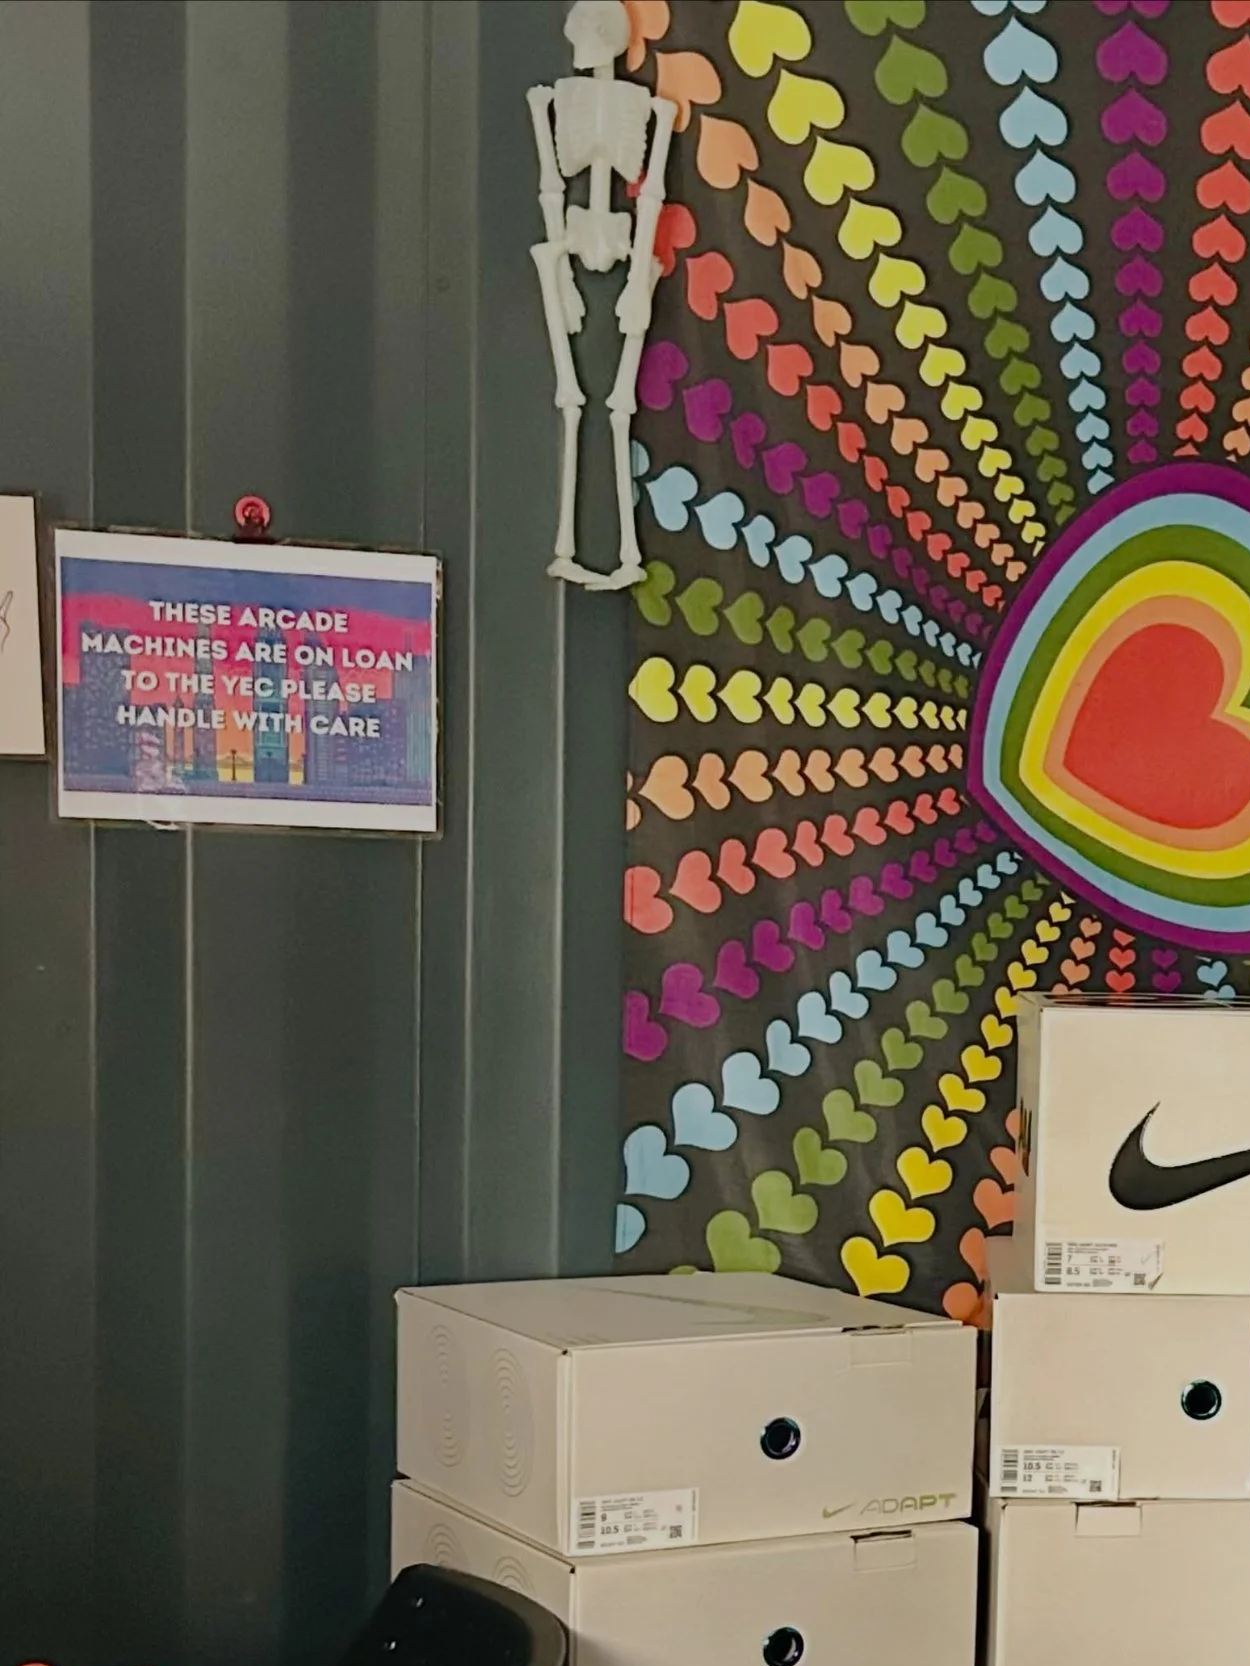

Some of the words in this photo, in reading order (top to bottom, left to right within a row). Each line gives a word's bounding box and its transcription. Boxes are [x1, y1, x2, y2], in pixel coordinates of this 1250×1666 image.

[150, 600, 232, 626] THESE
[238, 607, 349, 633] ARCADE
[81, 631, 228, 661] MACHINES
[235, 642, 288, 664] ARE
[294, 645, 335, 667] ON
[342, 647, 413, 672] LOAN
[121, 669, 158, 692] TO
[165, 671, 215, 695] THE
[221, 675, 274, 698] YEC
[282, 678, 376, 704] PLEASE
[116, 704, 226, 731] HANDLE
[233, 710, 303, 734] WITH
[310, 715, 381, 739] CARE
[1023, 1462, 1041, 1470] 10.5
[860, 1493, 957, 1516] ADAPT
